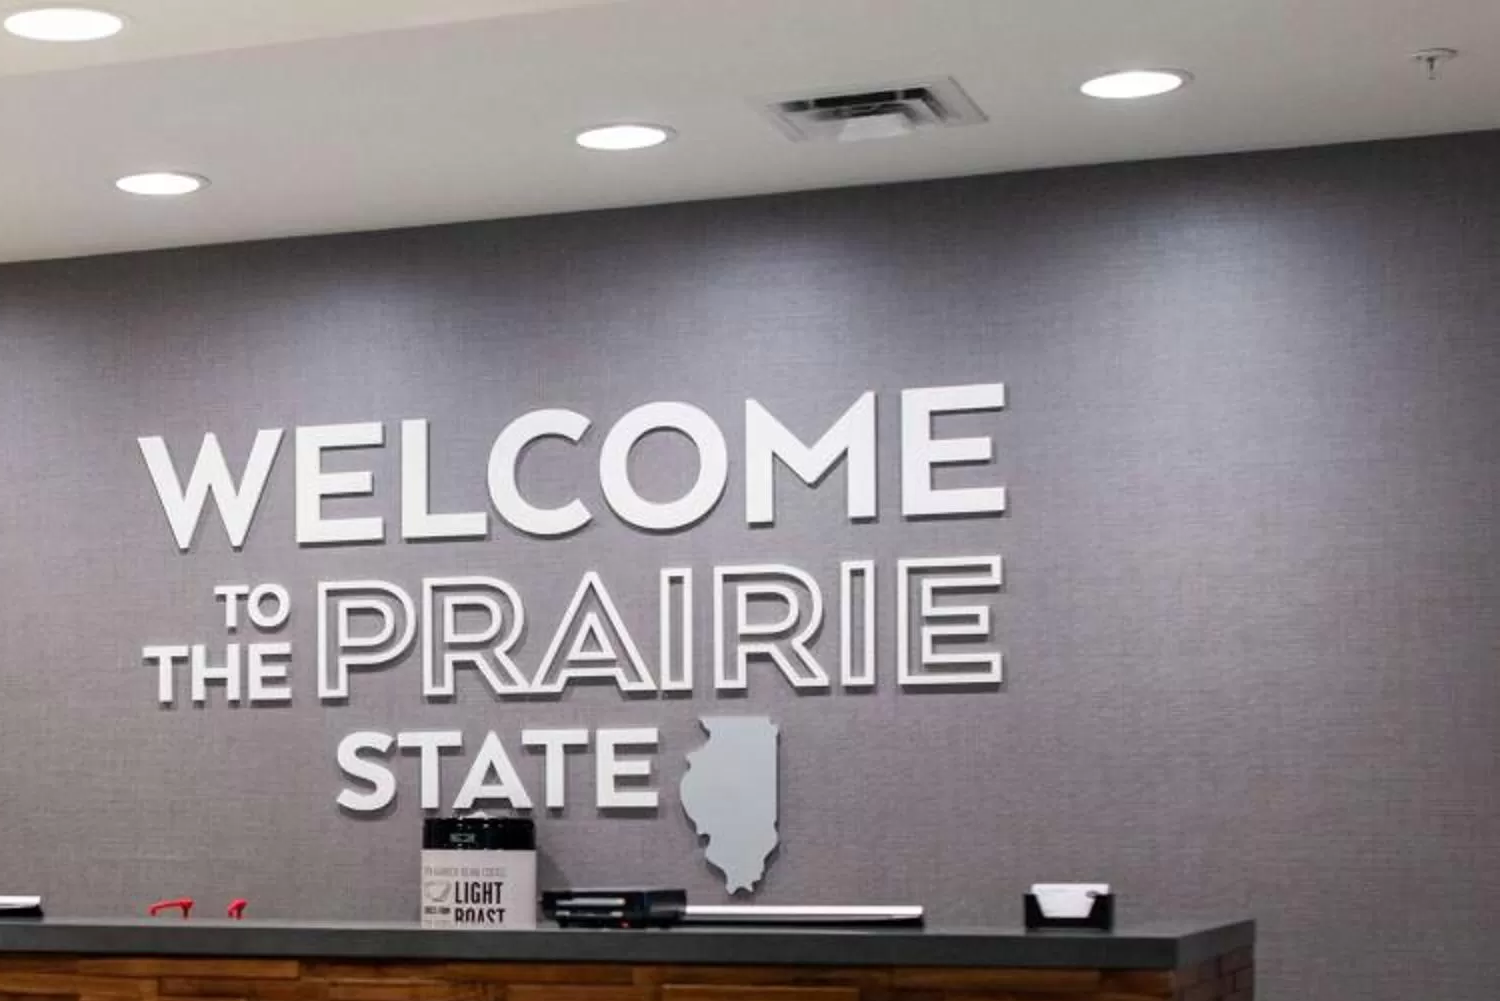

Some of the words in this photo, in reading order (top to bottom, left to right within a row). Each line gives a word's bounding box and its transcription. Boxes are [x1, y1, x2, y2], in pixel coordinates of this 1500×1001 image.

[137, 382, 1006, 551] WELCOME
[142, 642, 293, 703] THE
[316, 554, 1004, 701] PRAIRIE
[213, 582, 292, 629] TO
[335, 727, 660, 812] STATE
[455, 881, 504, 905] LIGHT
